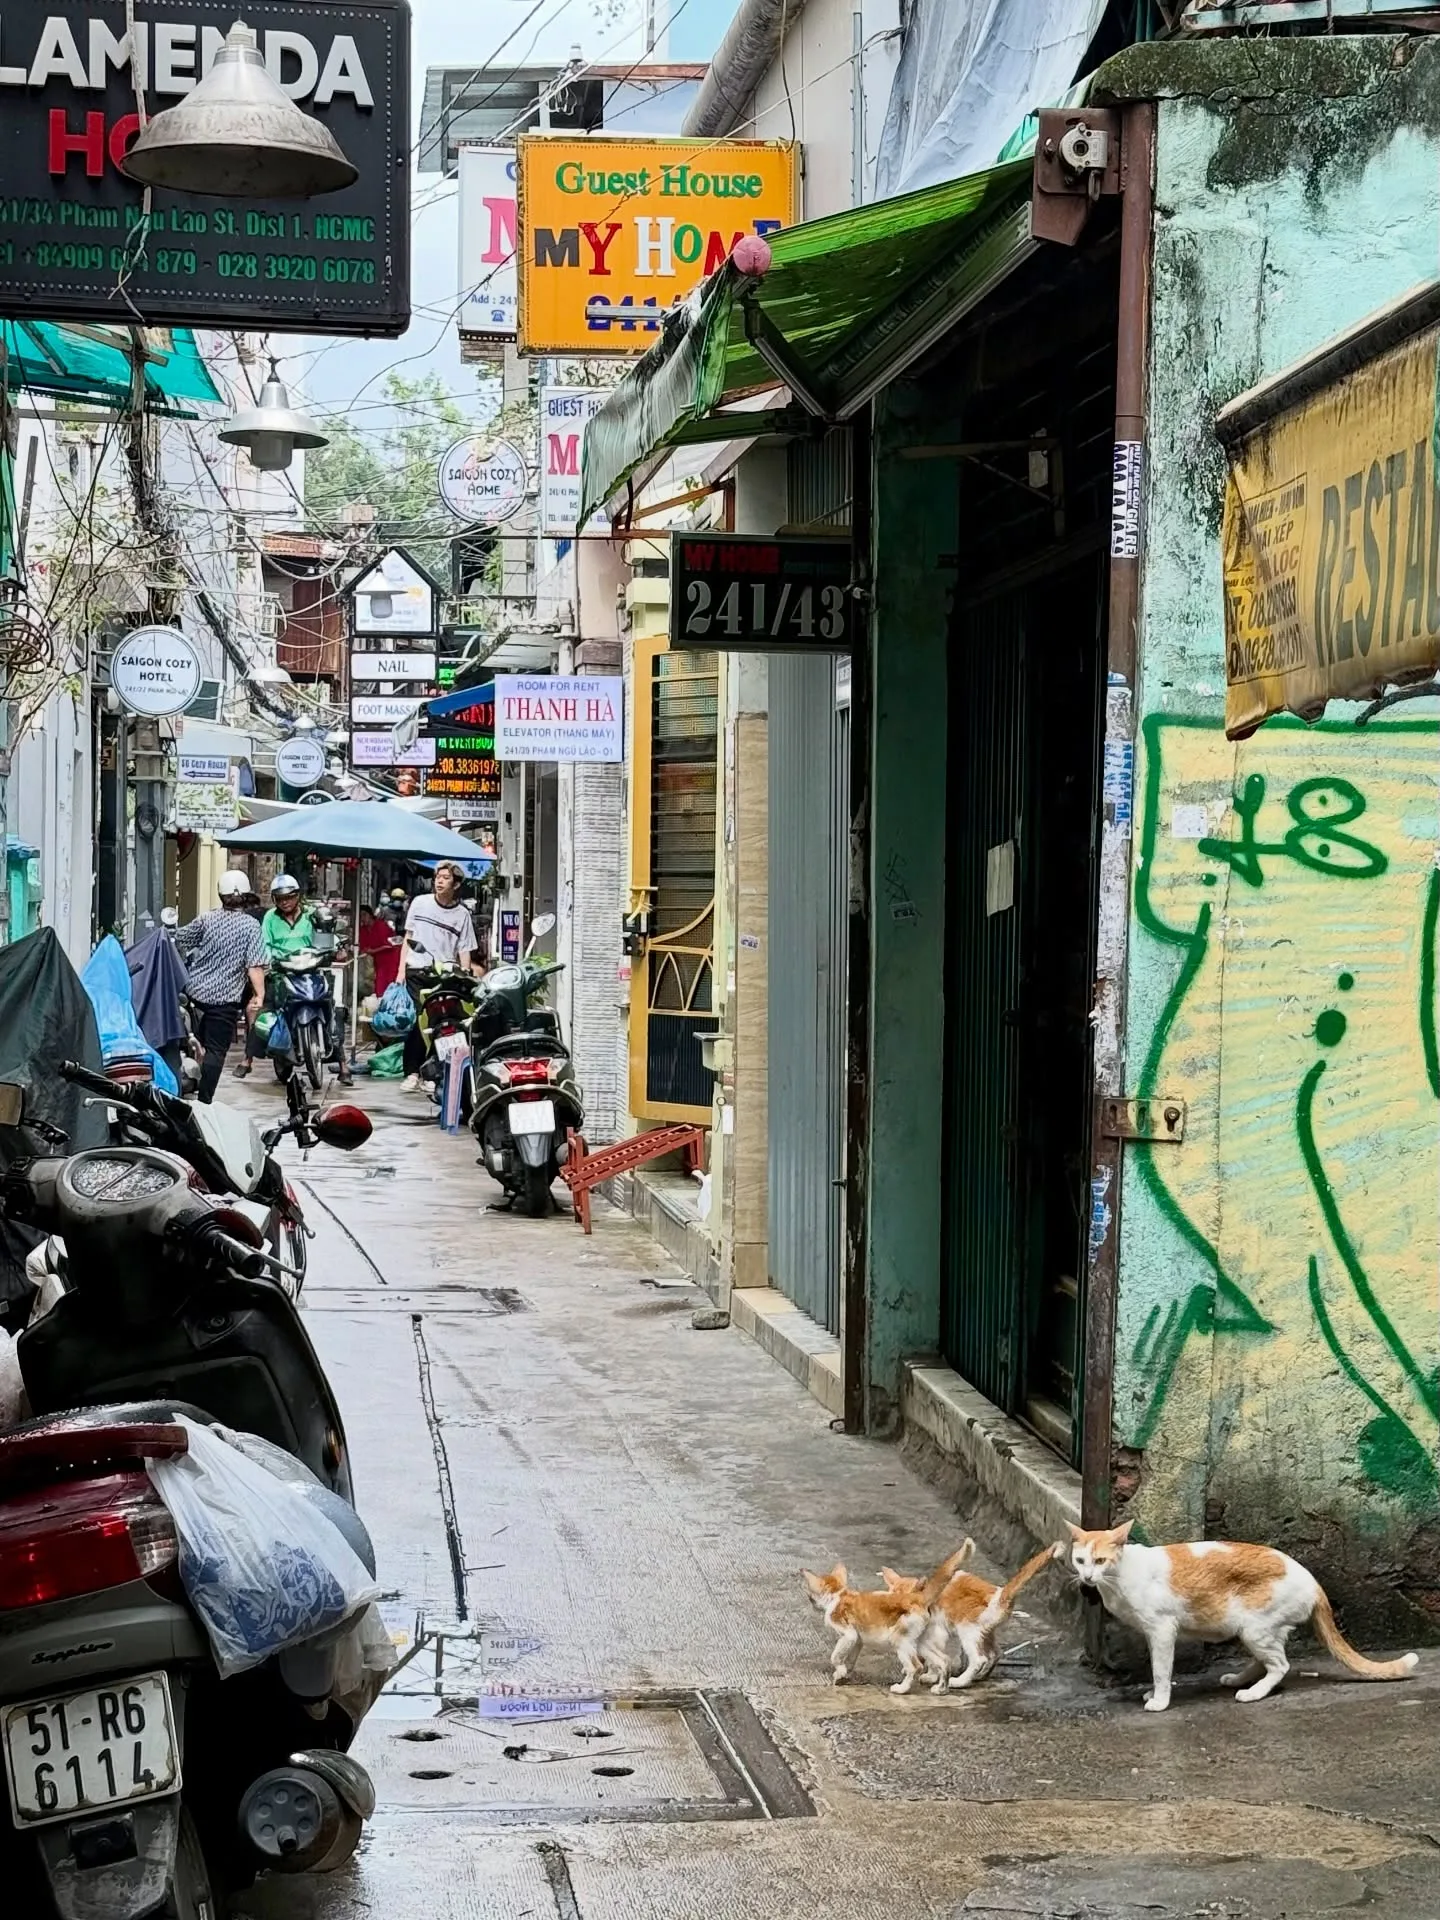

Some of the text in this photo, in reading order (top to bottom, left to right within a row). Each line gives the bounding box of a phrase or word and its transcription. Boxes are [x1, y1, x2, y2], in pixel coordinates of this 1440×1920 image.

[555, 161, 650, 196] Guest
[659, 164, 764, 198] House
[60, 202, 118, 228] Pham
[125, 206, 165, 230] Nu
[171, 209, 207, 233] Lao
[246, 212, 285, 238] Dist
[315, 217, 376, 242] HCMC
[533, 222, 622, 276] MY
[156, 250, 197, 275] 879
[217, 252, 258, 279] 028
[264, 255, 317, 281] 3920
[323, 259, 375, 285] 6078
[471, 294, 489, 304] Add
[548, 400, 583, 416] GUEST
[448, 469, 517, 481] SAIGON COZY
[467, 485, 500, 495] HOME
[685, 580, 845, 639] 241/43
[121, 656, 192, 669] SAIGON COZY
[378, 660, 409, 673] NAIL
[139, 672, 173, 682] HOTEL
[517, 681, 601, 692] ROOM FOR RENT
[358, 705, 383, 715] FOOT
[503, 697, 578, 721] THANH
[584, 692, 616, 722] HÀ
[503, 728, 551, 737] ELEVATOR
[33, 1740, 156, 1811] 6114
